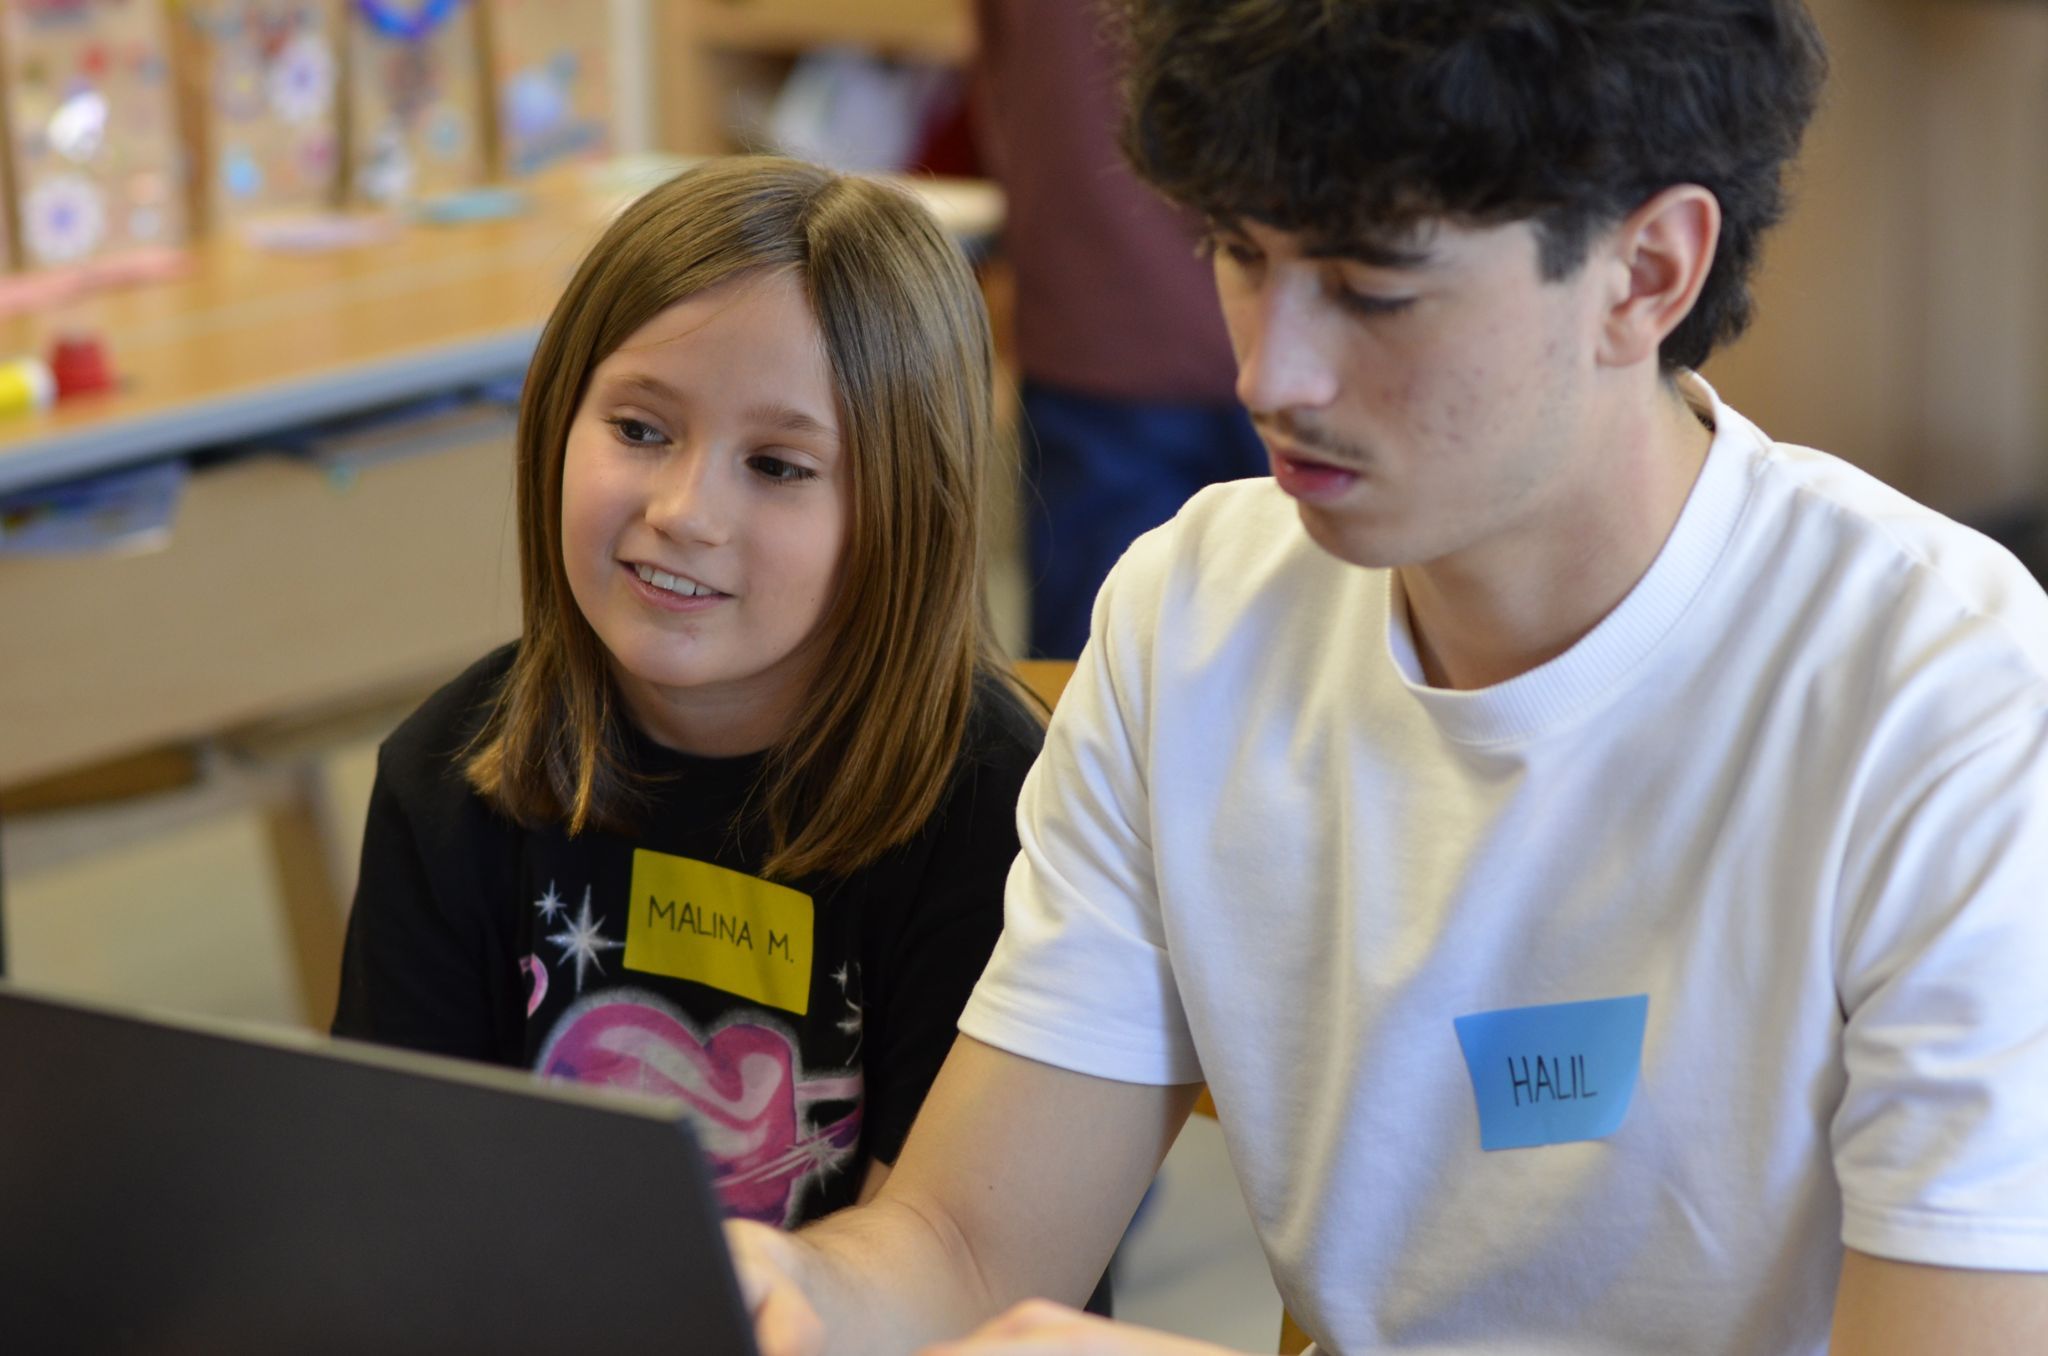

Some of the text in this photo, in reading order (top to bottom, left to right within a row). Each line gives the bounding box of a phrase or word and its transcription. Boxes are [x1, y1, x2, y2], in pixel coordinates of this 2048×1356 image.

[648, 895, 794, 963] MALINA M.
[1507, 1054, 1598, 1107] HALIL
